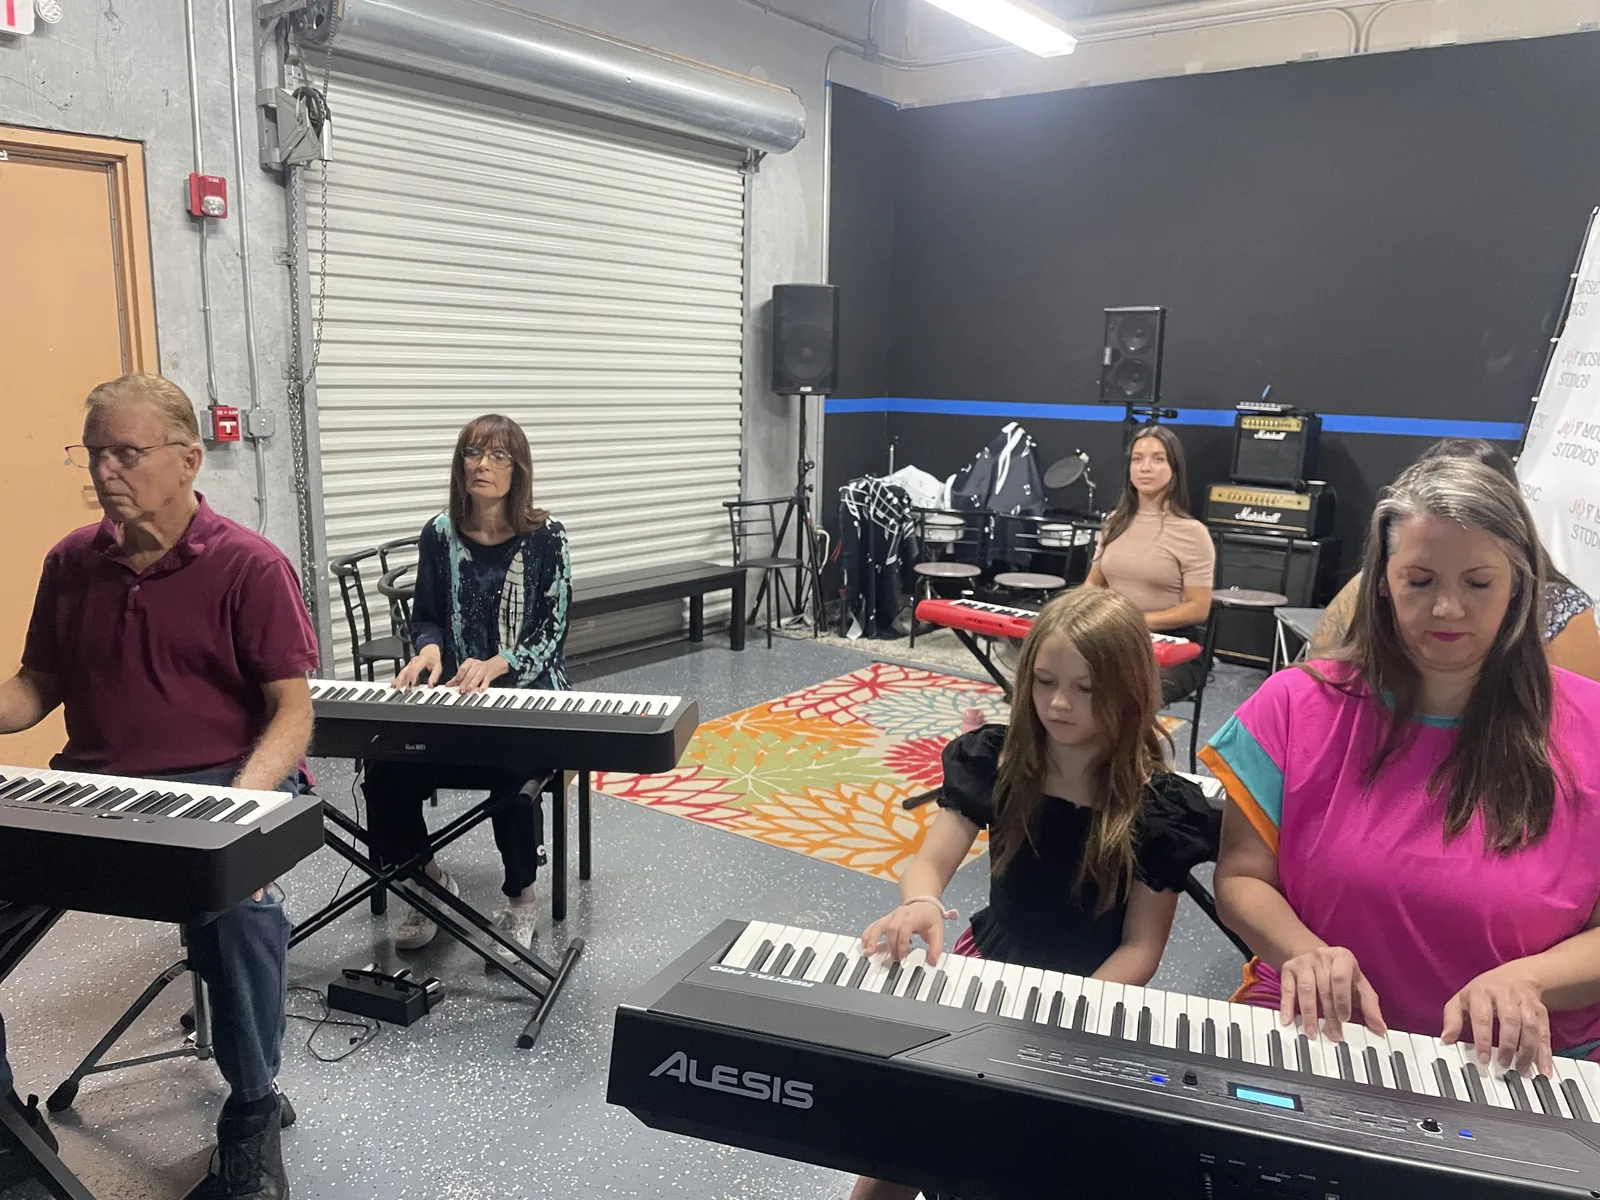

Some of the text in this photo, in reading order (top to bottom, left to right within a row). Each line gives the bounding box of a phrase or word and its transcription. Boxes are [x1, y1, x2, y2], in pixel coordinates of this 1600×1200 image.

[1254, 429, 1287, 441] Marshall
[1552, 442, 1599, 466] STUDIOS
[1235, 506, 1281, 523] Marshall
[1571, 523, 1600, 549] STUD
[709, 965, 815, 988] RECITAL PRO
[648, 1051, 814, 1110] ALESIS
